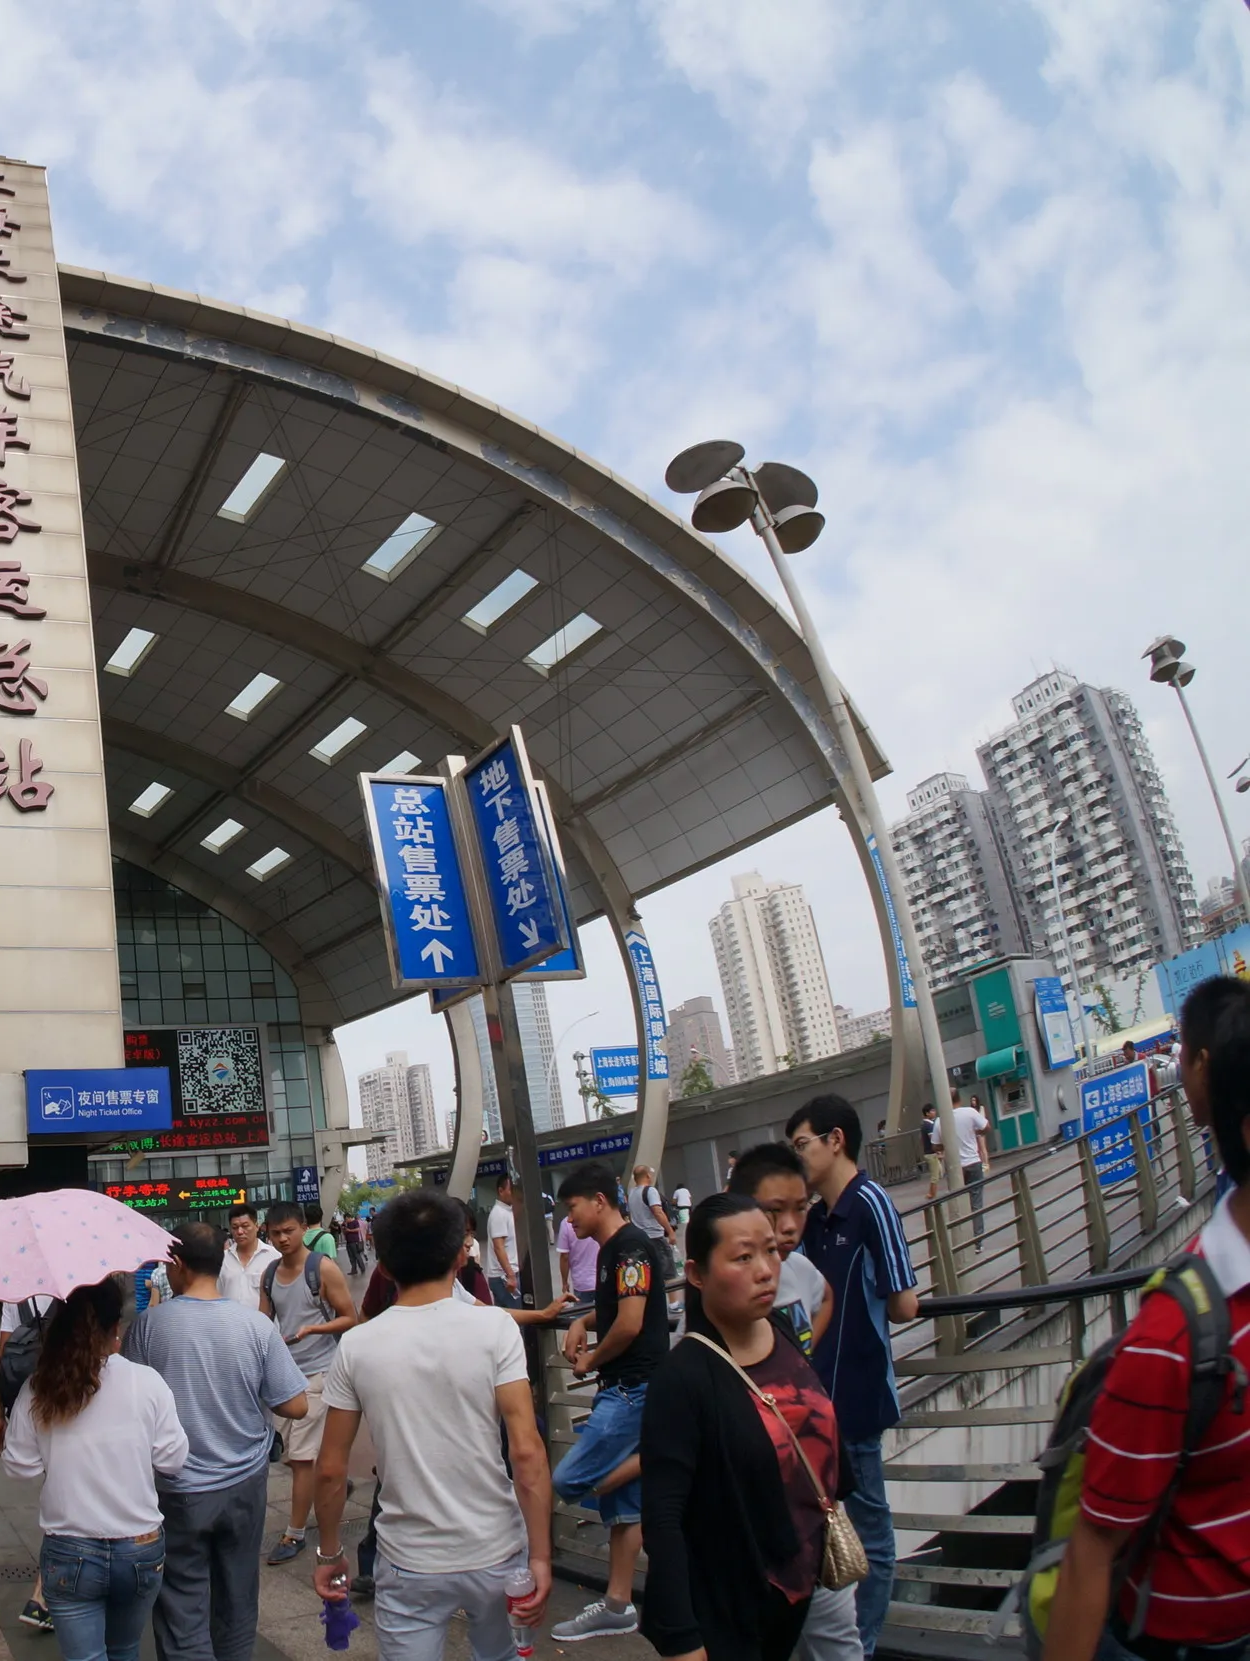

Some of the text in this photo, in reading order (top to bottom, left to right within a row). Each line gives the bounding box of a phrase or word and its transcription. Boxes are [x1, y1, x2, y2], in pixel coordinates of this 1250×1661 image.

[479, 759, 537, 917] 地下售票处
[389, 788, 453, 932] 总站售票处
[639, 949, 668, 1075] 上海国际眼镜城
[77, 1089, 159, 1106] 夜间售票专窗
[78, 1108, 142, 1118] Night Ticket Office
[172, 1115, 265, 1129] w.kyzz.com.cn
[105, 1183, 170, 1198] 行李寄存
